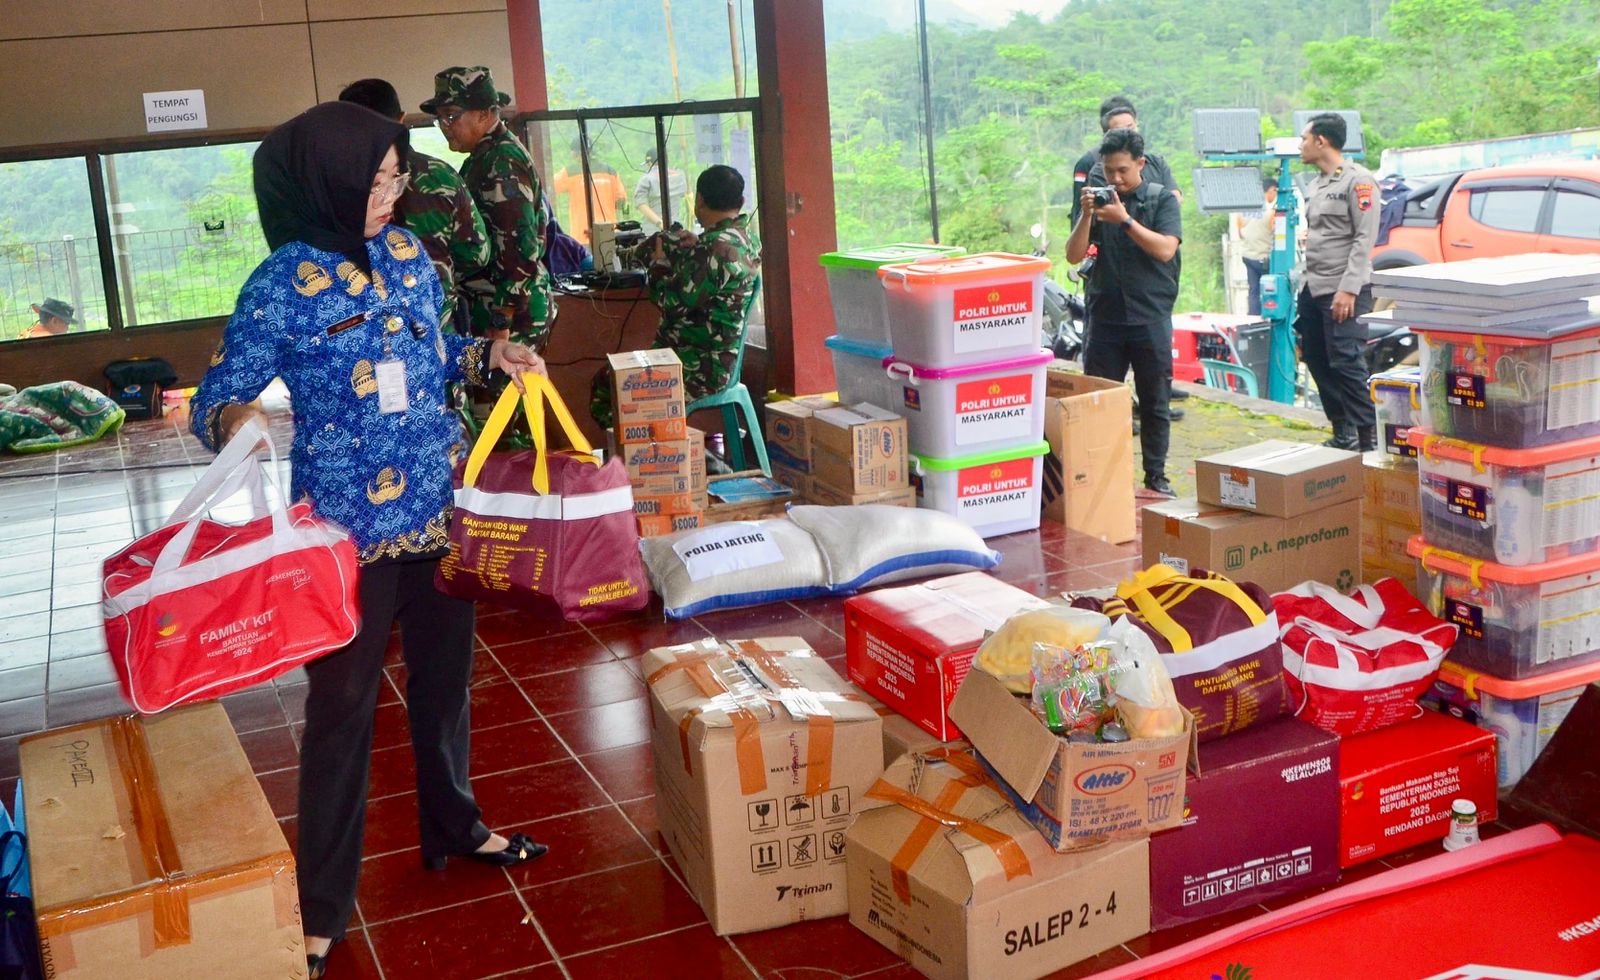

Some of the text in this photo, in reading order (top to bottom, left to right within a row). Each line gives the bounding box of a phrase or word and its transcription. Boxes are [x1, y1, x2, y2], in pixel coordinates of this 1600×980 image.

[152, 98, 189, 108] TEMPAT
[148, 113, 198, 124] PENGUNGSI
[959, 302, 1027, 319] POLRI UNTUK
[959, 316, 1027, 332] MASYARAKAT
[671, 405, 678, 415] 8
[961, 394, 1027, 411] POLRI UNTUK
[961, 408, 1026, 424] MASYARAKAT
[678, 480, 685, 490] 8
[963, 477, 1028, 496] POLRI UNTUK
[963, 491, 1027, 508] MASYARAKAT
[490, 530, 520, 542] BARANG
[508, 523, 529, 533] WARE
[684, 532, 766, 558] POLDA JATENG
[1249, 541, 1273, 561] p.t.
[587, 584, 608, 596] TIDAK
[199, 617, 249, 645] FAMILY
[252, 609, 275, 628] KIT
[222, 630, 259, 649] BANTUAN
[232, 646, 253, 659] 2024
[1238, 659, 1261, 673] WARE
[1202, 683, 1231, 696] DAFTAR
[1081, 750, 1096, 759] AIR
[1281, 756, 1331, 778] #KEMENSOS
[1081, 769, 1127, 790] Altis
[1379, 783, 1405, 796] Bantuan
[1405, 775, 1433, 788] Makanan
[1379, 775, 1460, 806] KEMENTERIAN SOSIAL
[1380, 784, 1461, 815] REPUBLIK INDONESIA
[1069, 818, 1082, 828] ISI
[1090, 816, 1100, 826] 48
[1110, 811, 1125, 822] 220
[1410, 803, 1431, 819] 2025
[1384, 809, 1453, 837] RENDANG DAGIN
[791, 882, 833, 898] Triman
[1004, 912, 1073, 957] SALEP
[1078, 902, 1090, 930] 2
[1105, 890, 1117, 916] 4
